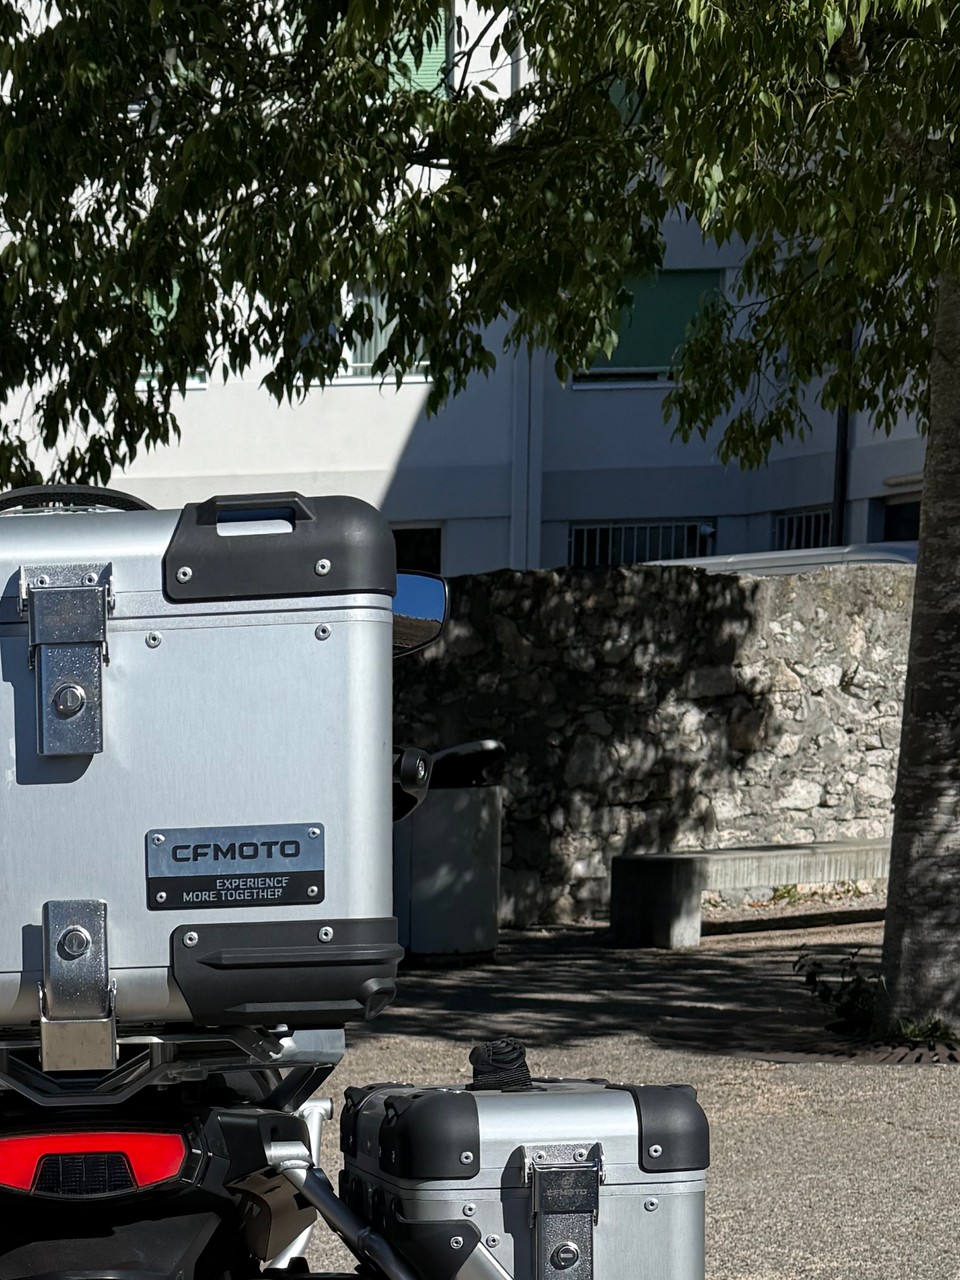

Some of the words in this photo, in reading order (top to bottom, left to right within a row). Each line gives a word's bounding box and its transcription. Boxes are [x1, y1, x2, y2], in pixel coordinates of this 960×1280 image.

[171, 840, 301, 863] CFMOTO
[216, 876, 290, 890] EXPERIENCE
[183, 891, 217, 902] MORE
[220, 888, 283, 901] TOGETHER
